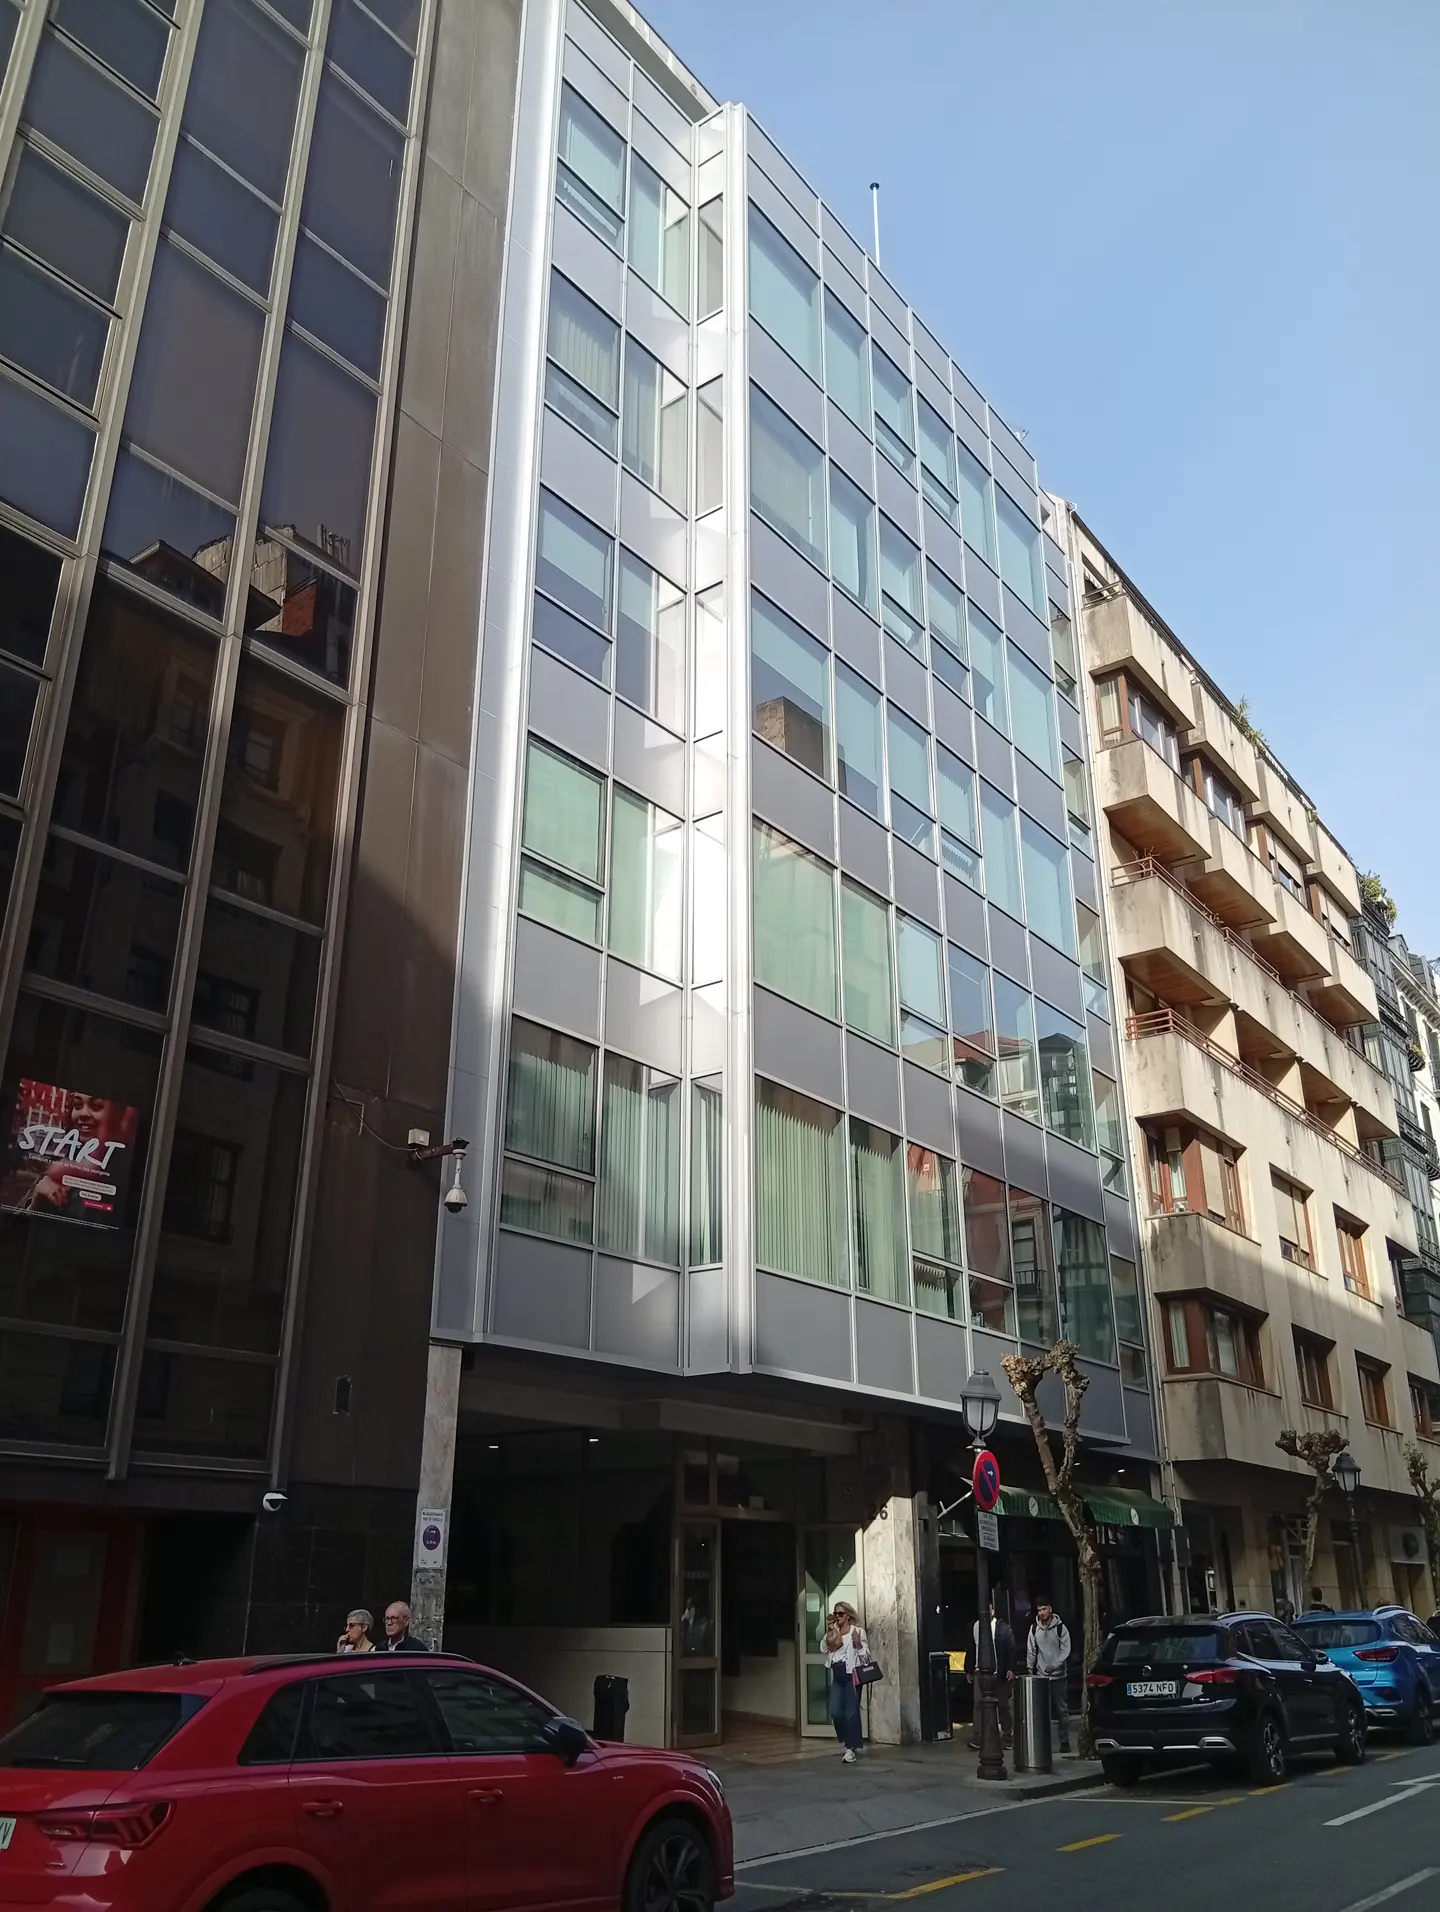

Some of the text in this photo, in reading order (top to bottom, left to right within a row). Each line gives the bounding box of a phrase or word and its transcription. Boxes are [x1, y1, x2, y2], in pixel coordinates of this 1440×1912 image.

[19, 1125, 126, 1169] START
[867, 1499, 889, 1520] 26
[1133, 1683, 1154, 1694] 5374
